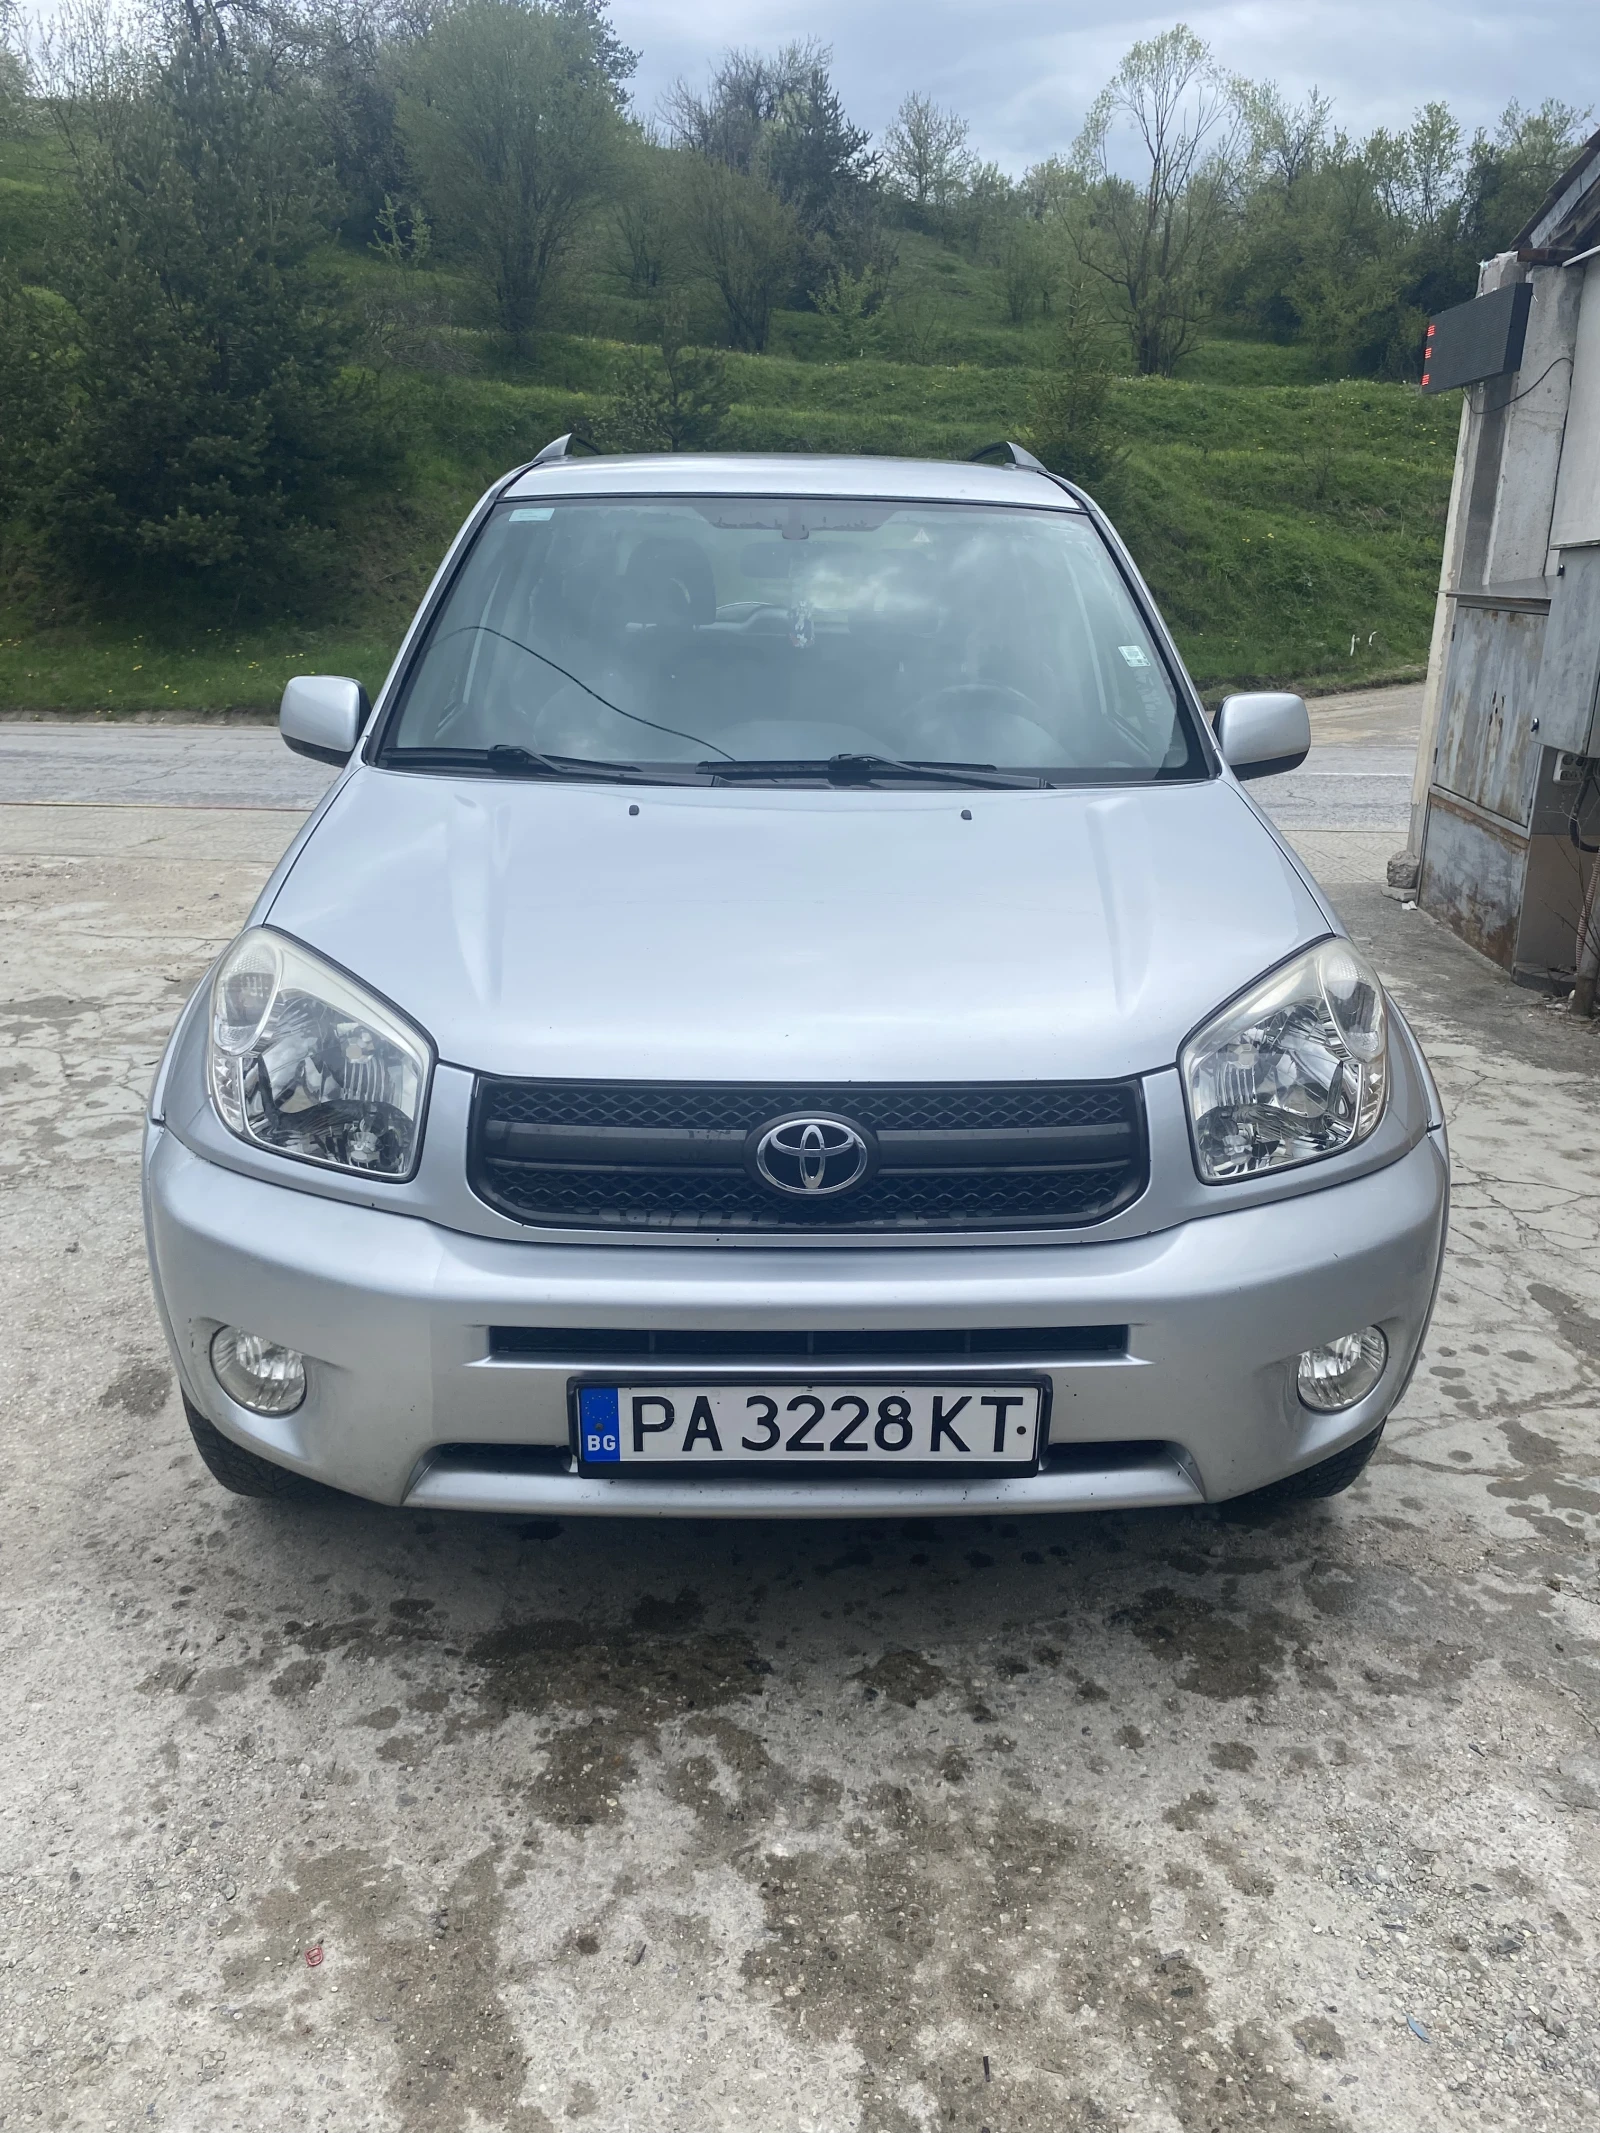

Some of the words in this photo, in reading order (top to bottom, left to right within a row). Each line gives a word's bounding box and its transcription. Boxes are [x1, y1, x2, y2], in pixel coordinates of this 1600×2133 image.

[586, 1434, 616, 1452] BG
[632, 1396, 723, 1453] PA
[741, 1395, 913, 1452] 3228
[929, 1396, 1024, 1452] KT
